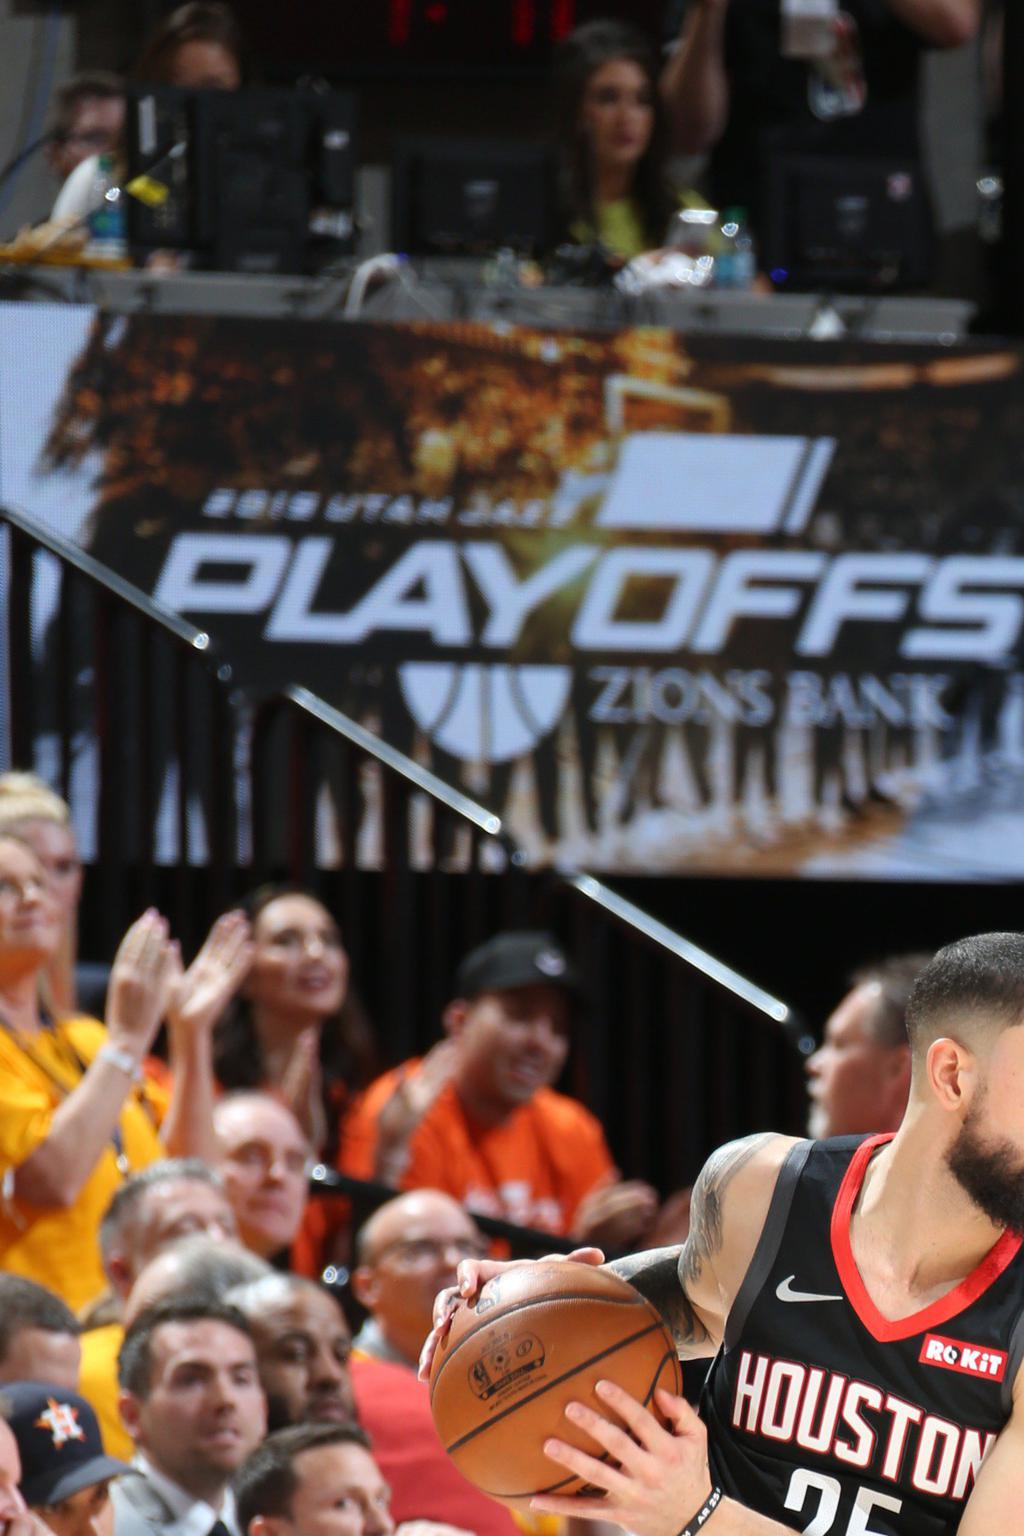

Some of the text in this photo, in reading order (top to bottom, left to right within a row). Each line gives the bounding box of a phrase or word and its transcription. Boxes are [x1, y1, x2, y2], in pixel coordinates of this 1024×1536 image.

[588, 665, 956, 732] ZIONS BANK
[732, 1350, 999, 1501] HOUSTON
